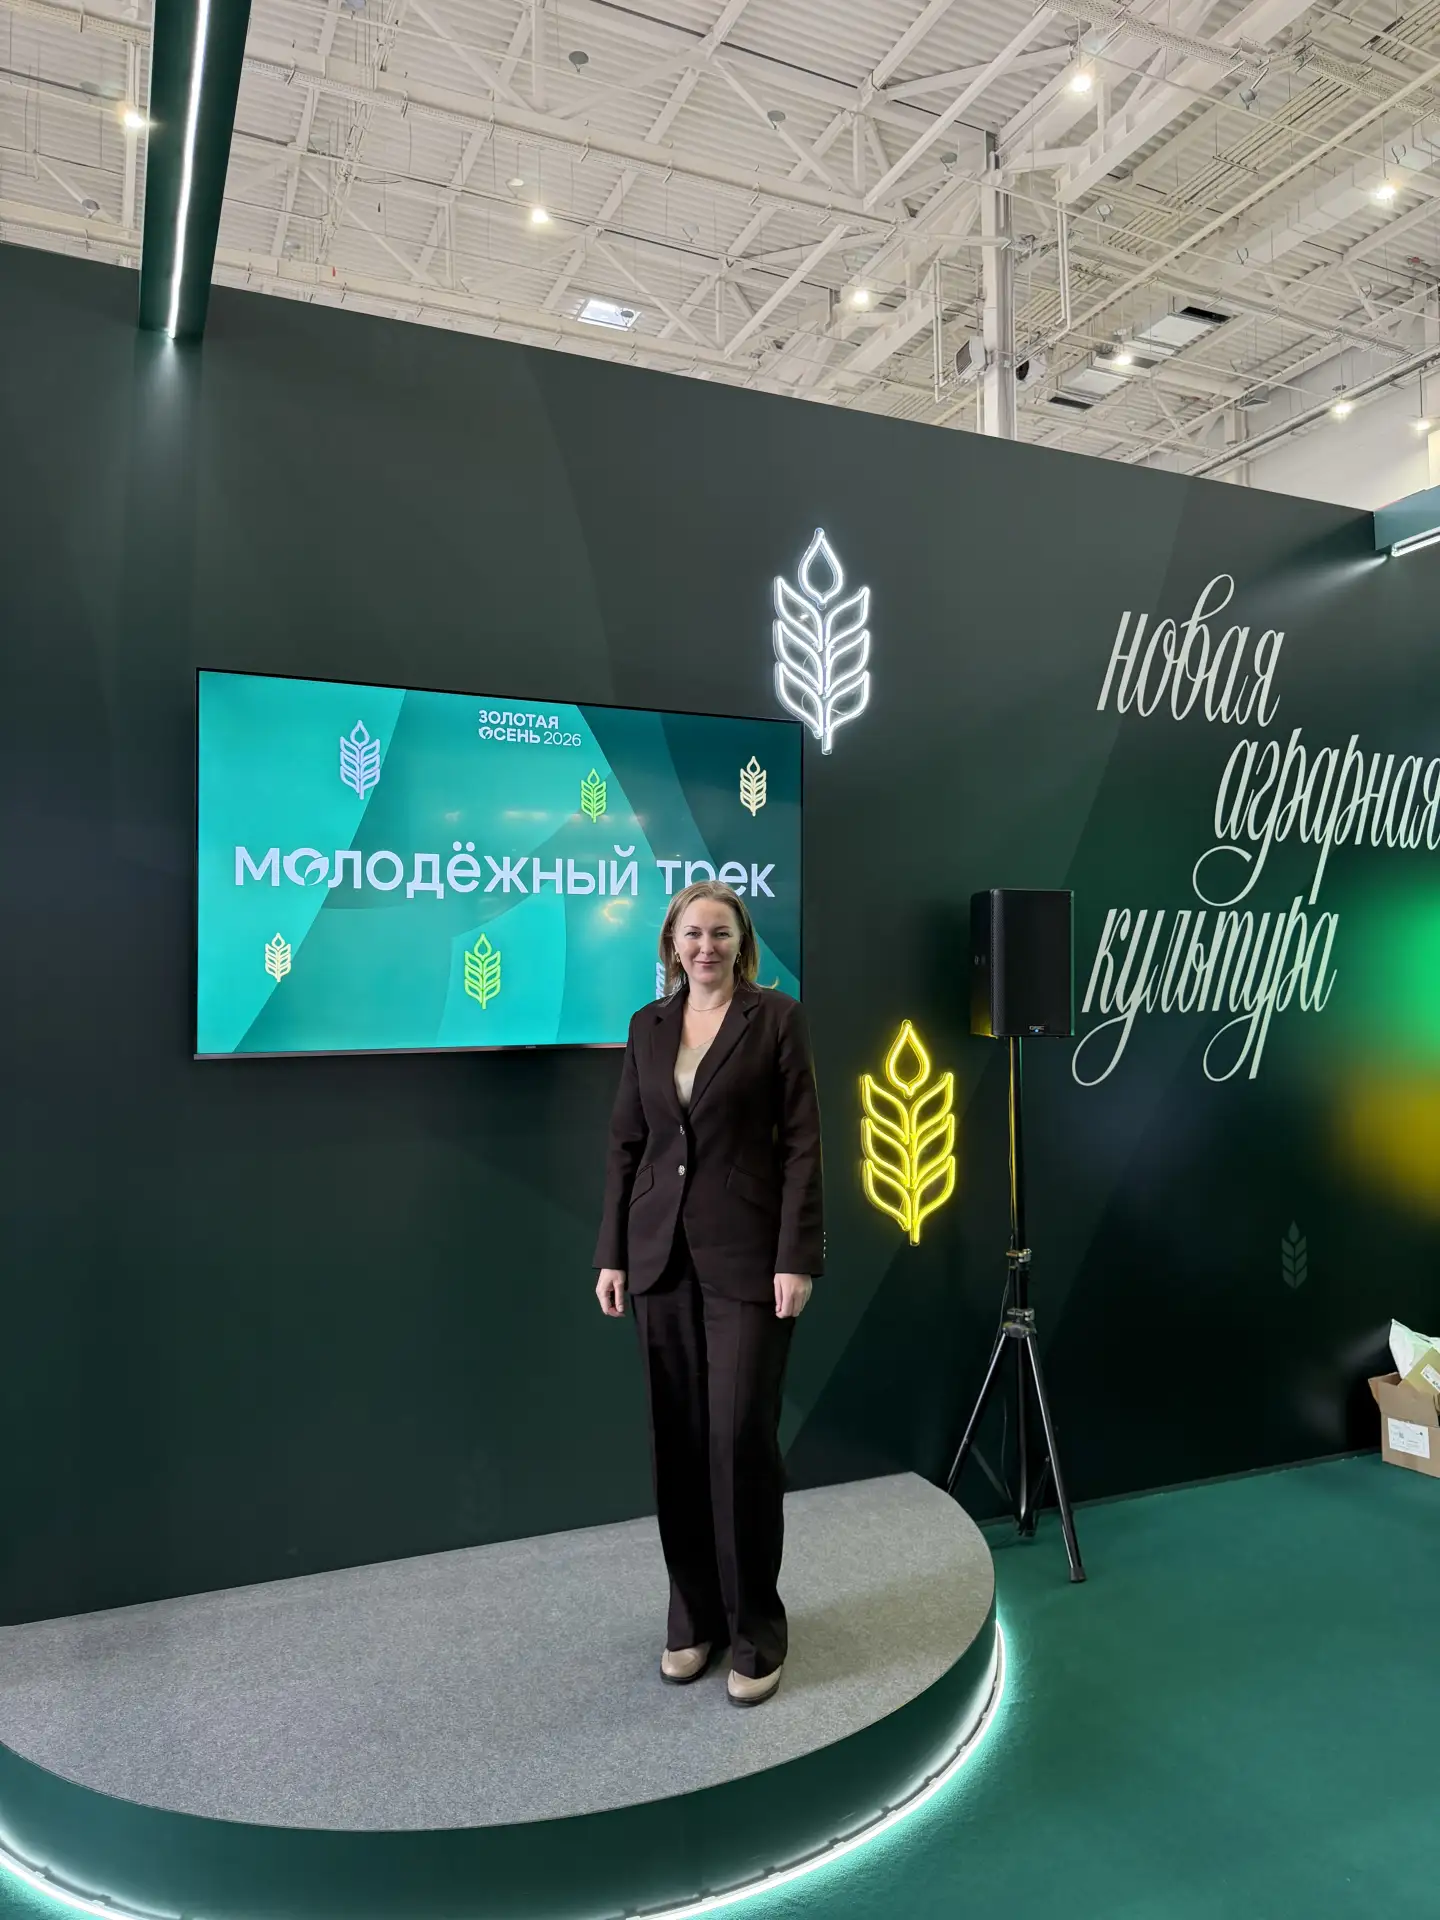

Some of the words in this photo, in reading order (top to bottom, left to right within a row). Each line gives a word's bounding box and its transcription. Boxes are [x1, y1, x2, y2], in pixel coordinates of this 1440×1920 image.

[1096, 573, 1285, 727] новая
[478, 709, 559, 730] ЗОЛОТАЯ
[478, 726, 541, 744] ОСЕНЬ
[543, 731, 582, 747] 2026
[1193, 727, 1440, 906] аграрная
[656, 859, 776, 898] трек
[1071, 895, 1339, 1087] культура
